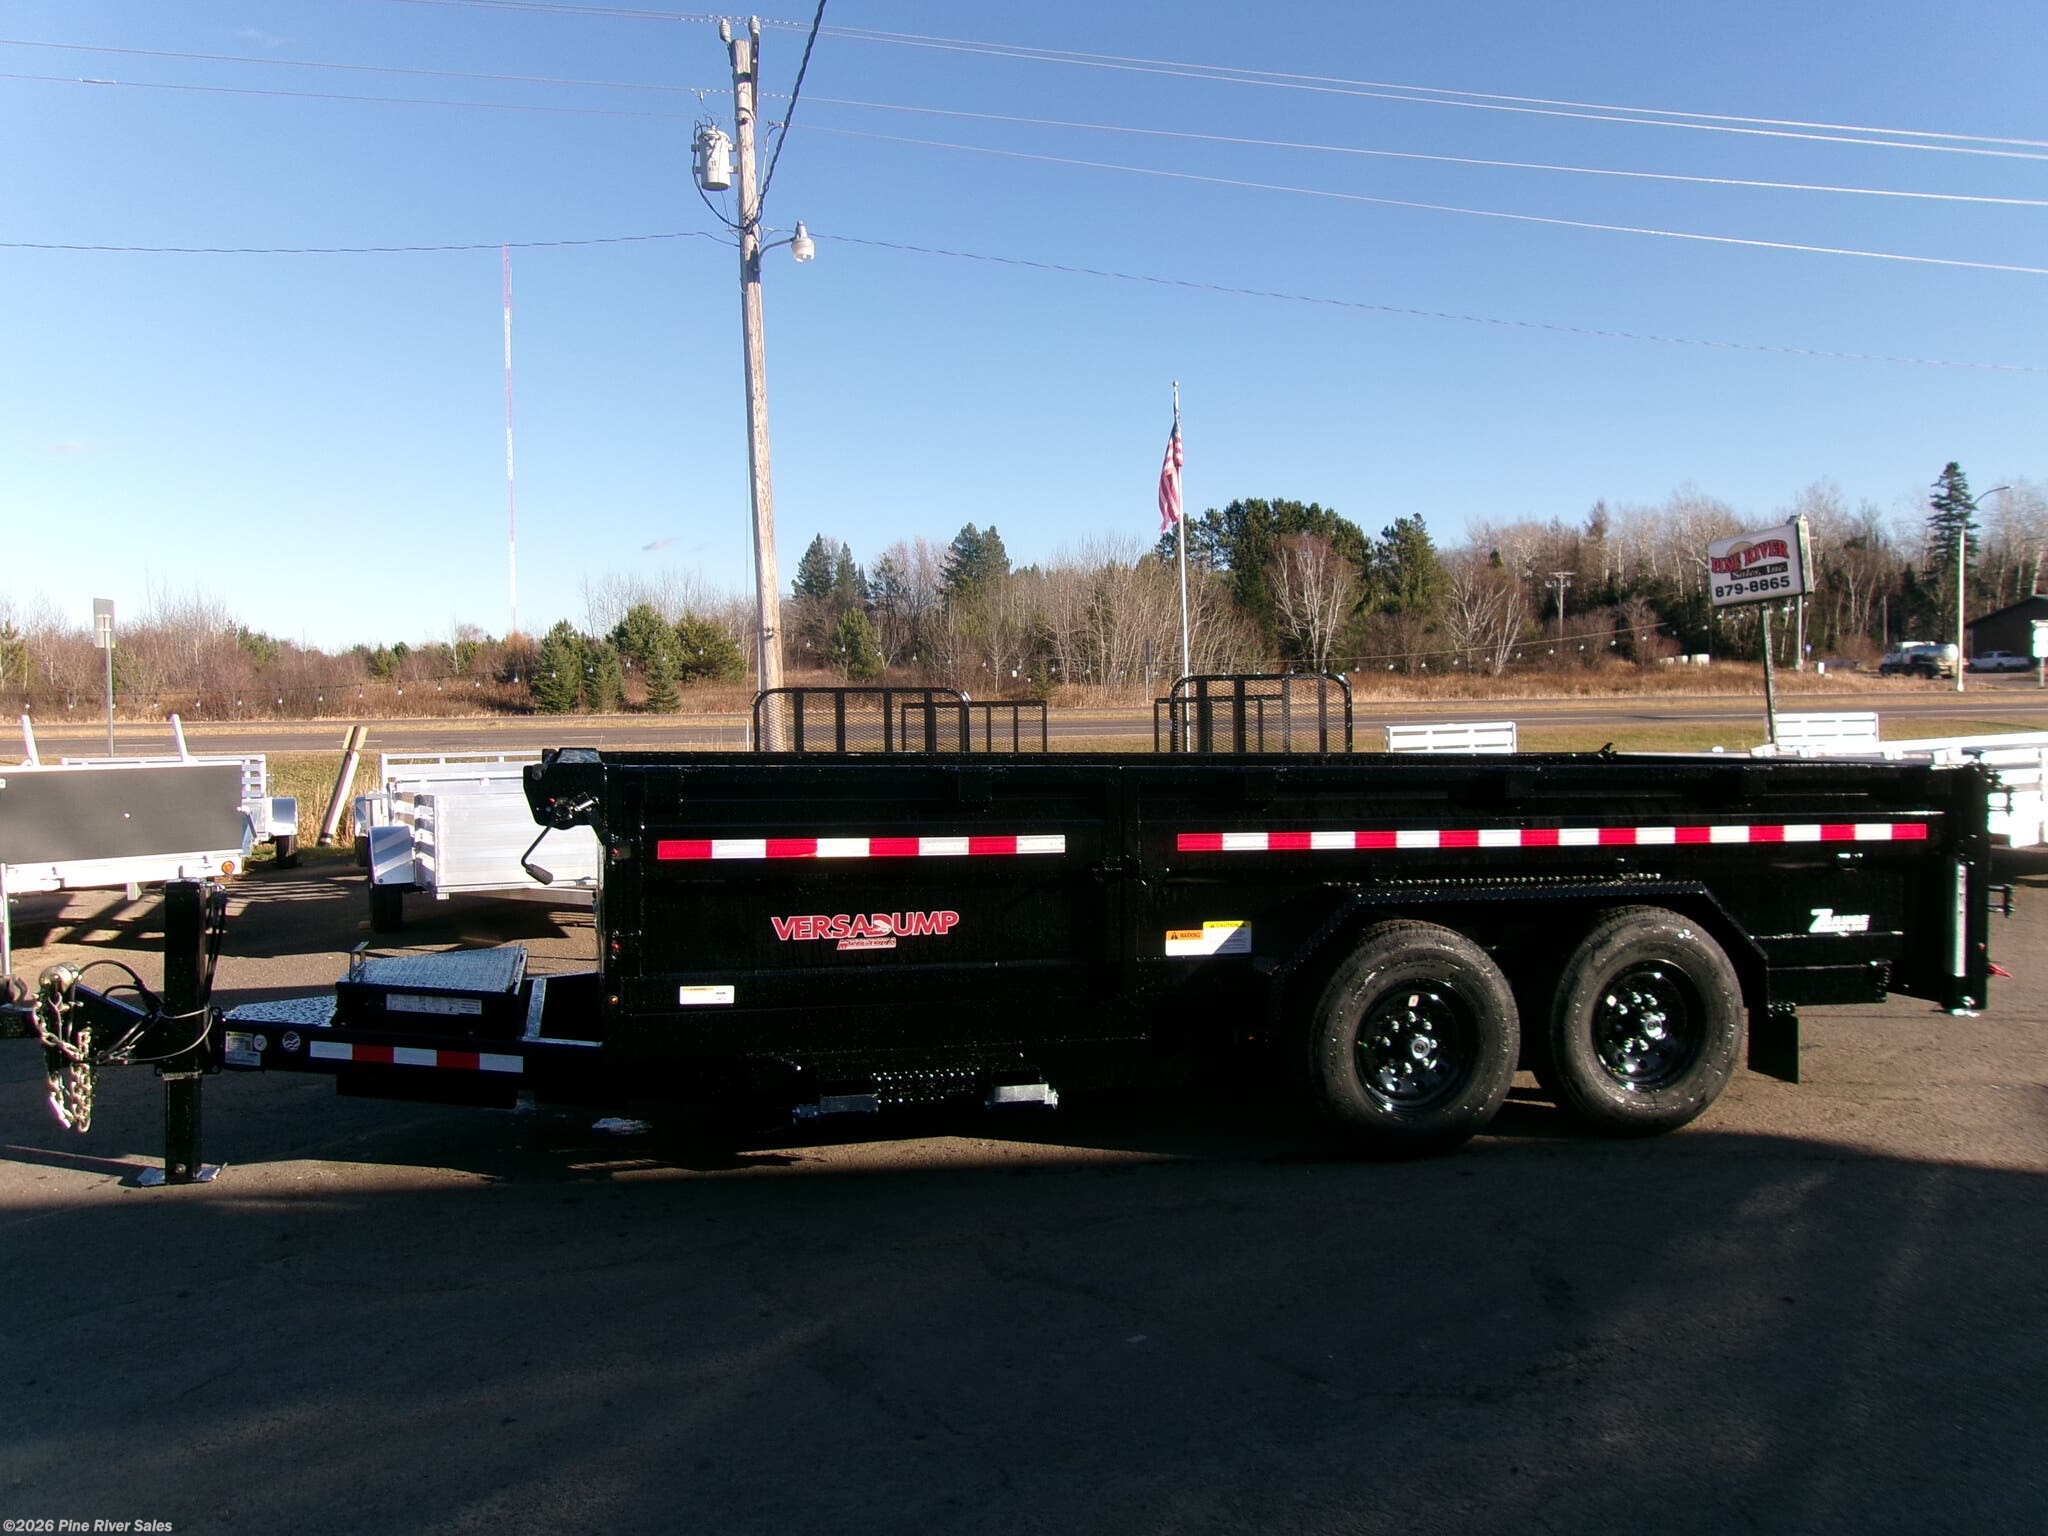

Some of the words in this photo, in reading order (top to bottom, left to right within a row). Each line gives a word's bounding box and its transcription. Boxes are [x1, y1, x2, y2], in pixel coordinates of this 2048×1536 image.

[1711, 552, 1742, 574] PINE
[1744, 539, 1790, 566] RIVER
[1715, 576, 1790, 597] 879-8865
[771, 910, 960, 941] VERSADUMP
